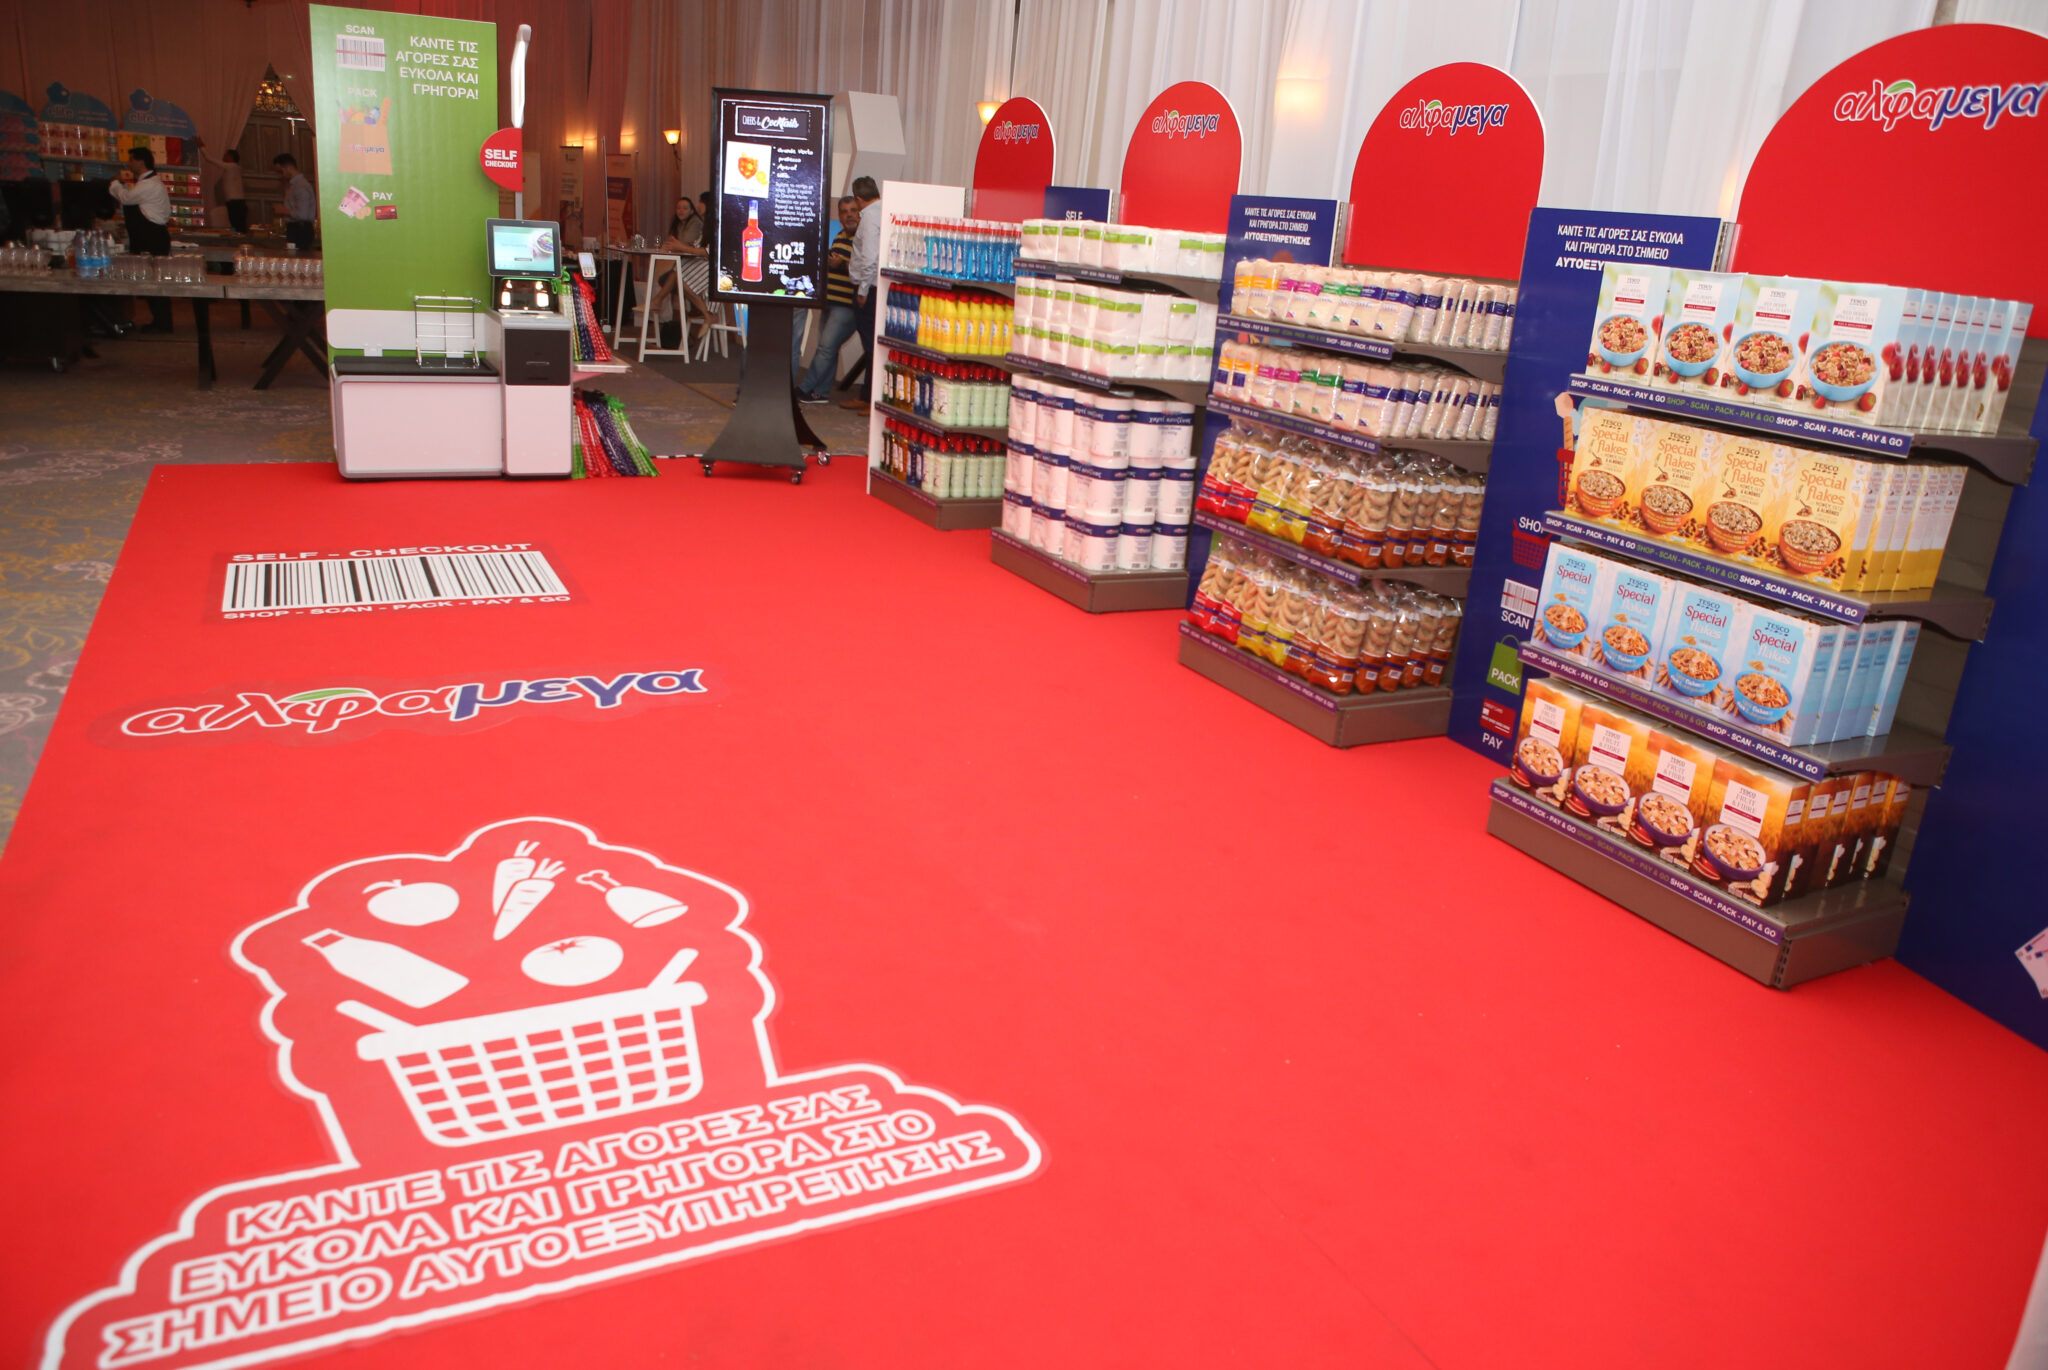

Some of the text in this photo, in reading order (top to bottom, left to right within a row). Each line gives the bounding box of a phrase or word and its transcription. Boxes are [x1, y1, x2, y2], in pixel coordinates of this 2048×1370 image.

[345, 24, 375, 35] SCAN
[410, 36, 478, 53] ΚΑΝΤΕ ΤΙΣ
[396, 51, 478, 69] ΑΓΟΡΕΣ ΣΑΣ
[400, 68, 478, 84] ΕΥΚΟΛΑ ΚΑΙ
[348, 87, 377, 98] PACK
[413, 84, 479, 100] ΓΡΗΓΟΡΑ!
[1834, 79, 2048, 132] αλφαμεγα
[1152, 110, 1220, 138] αλφαμεγα
[1399, 100, 1509, 136] αλφαμεγα
[994, 120, 1040, 144] αλφαμεγα
[484, 149, 518, 160] SELF
[485, 160, 517, 168] CHECKOUT
[372, 192, 393, 200] PAY
[1066, 209, 1083, 221] SELF
[1245, 207, 1260, 216] ΚΑΝΤΕ
[1268, 208, 1286, 218] ΑΓΟΡΕΣ
[1287, 210, 1296, 219] ΣΑΣ
[1297, 210, 1316, 220] ΕΥΚΟΛΑ
[1249, 219, 1308, 232] ΚΑΙ ΓΡΗΓΟΡΑ ΣΤΟ ΣΗΜΕΙΟ
[1558, 224, 1684, 245] ΚΑΝΤΕ ΤΙΣ ΑΓΟΡΕΣ ΣΑΣ ΕΥΚΟΛΑ
[1244, 232, 1311, 245] ΑΥΤΟΕΞΥΠΗΡΕΤΗΣΗΣ
[1565, 241, 1669, 260] ΚΑΙ ΓΡΗΓΟΡΑ ΣΤΟ ΣΗΜΕΙΟ
[1556, 257, 1605, 271] ΑΥΤΟΕΞΥ
[1571, 379, 1588, 388] SHOP
[1592, 383, 1609, 393] SCAN
[1613, 387, 1630, 397] PACK
[1635, 391, 1648, 400] PAY
[1655, 395, 1665, 403] GO
[1666, 398, 1775, 423] SHOP SCAN PACK PAY GO
[1602, 419, 1622, 427] TESCO
[1776, 417, 1903, 447] SHOP SCAN PACK PAY & GO
[1592, 426, 1629, 442] Special
[1670, 432, 1691, 440] TESCO
[1596, 440, 1628, 456] flakes
[1659, 439, 1698, 458] Special
[1738, 446, 1760, 455] TESCO
[1664, 453, 1696, 471] flakes
[1725, 453, 1768, 473] Special
[1814, 462, 1839, 472] TESCO
[1731, 468, 1765, 487] flakes
[1800, 469, 1847, 491] Special
[1806, 486, 1844, 505] flakes
[1546, 518, 1636, 550] SHOP SCAN PACK PAY & GO
[232, 544, 532, 562] SELF CHECKOUT
[1636, 544, 1720, 575] SHOP SCAN PACK PAY
[1568, 558, 1586, 568] TESCO
[1557, 564, 1592, 584] Special
[1629, 578, 1649, 588] TESCO
[1616, 584, 1655, 605] Special
[1699, 598, 1720, 609] TESCO
[1739, 575, 1858, 617] SHOP SCAN PACK PAY & GO
[223, 610, 291, 619] SHOP
[311, 606, 373, 615] SCAN
[393, 601, 454, 611] PACK
[471, 598, 513, 606] PAY
[1685, 605, 1727, 628] Special
[1501, 611, 1530, 629] SCAN
[1767, 622, 1790, 633] TESCO
[1752, 628, 1797, 653] Special
[1491, 668, 1519, 688] PACK
[1522, 649, 1538, 660] SHOP
[1541, 656, 1557, 668] SCAN
[1560, 664, 1577, 676] PACK
[1581, 671, 1594, 683] PAY
[1599, 679, 1608, 688] GO
[120, 669, 708, 736] αλφαμεγα
[1482, 732, 1503, 749] PAY
[1707, 723, 1818, 775] SHOP SCAN PACK PAY & GO
[1493, 787, 1576, 834] SHOP SCAN PACK PAY & GO
[1670, 878, 1776, 938] SHOP SCAN PACK PAY & GO
[228, 1084, 883, 1246] ΚΑΝΤΕ ΤΙΣ ΑΓΟΡΕΣ ΣΑΣ
[170, 1109, 936, 1304] ΕΥΚΟΛΑ ΚΑΙ ΓΡΗΓΟΡΑ ΣΤΟ
[97, 1130, 1006, 1370] ΣΗΜΕΙΟ ΑΥΤΟΕΞΥΠΗΡΕΤΗΣΗΣ
